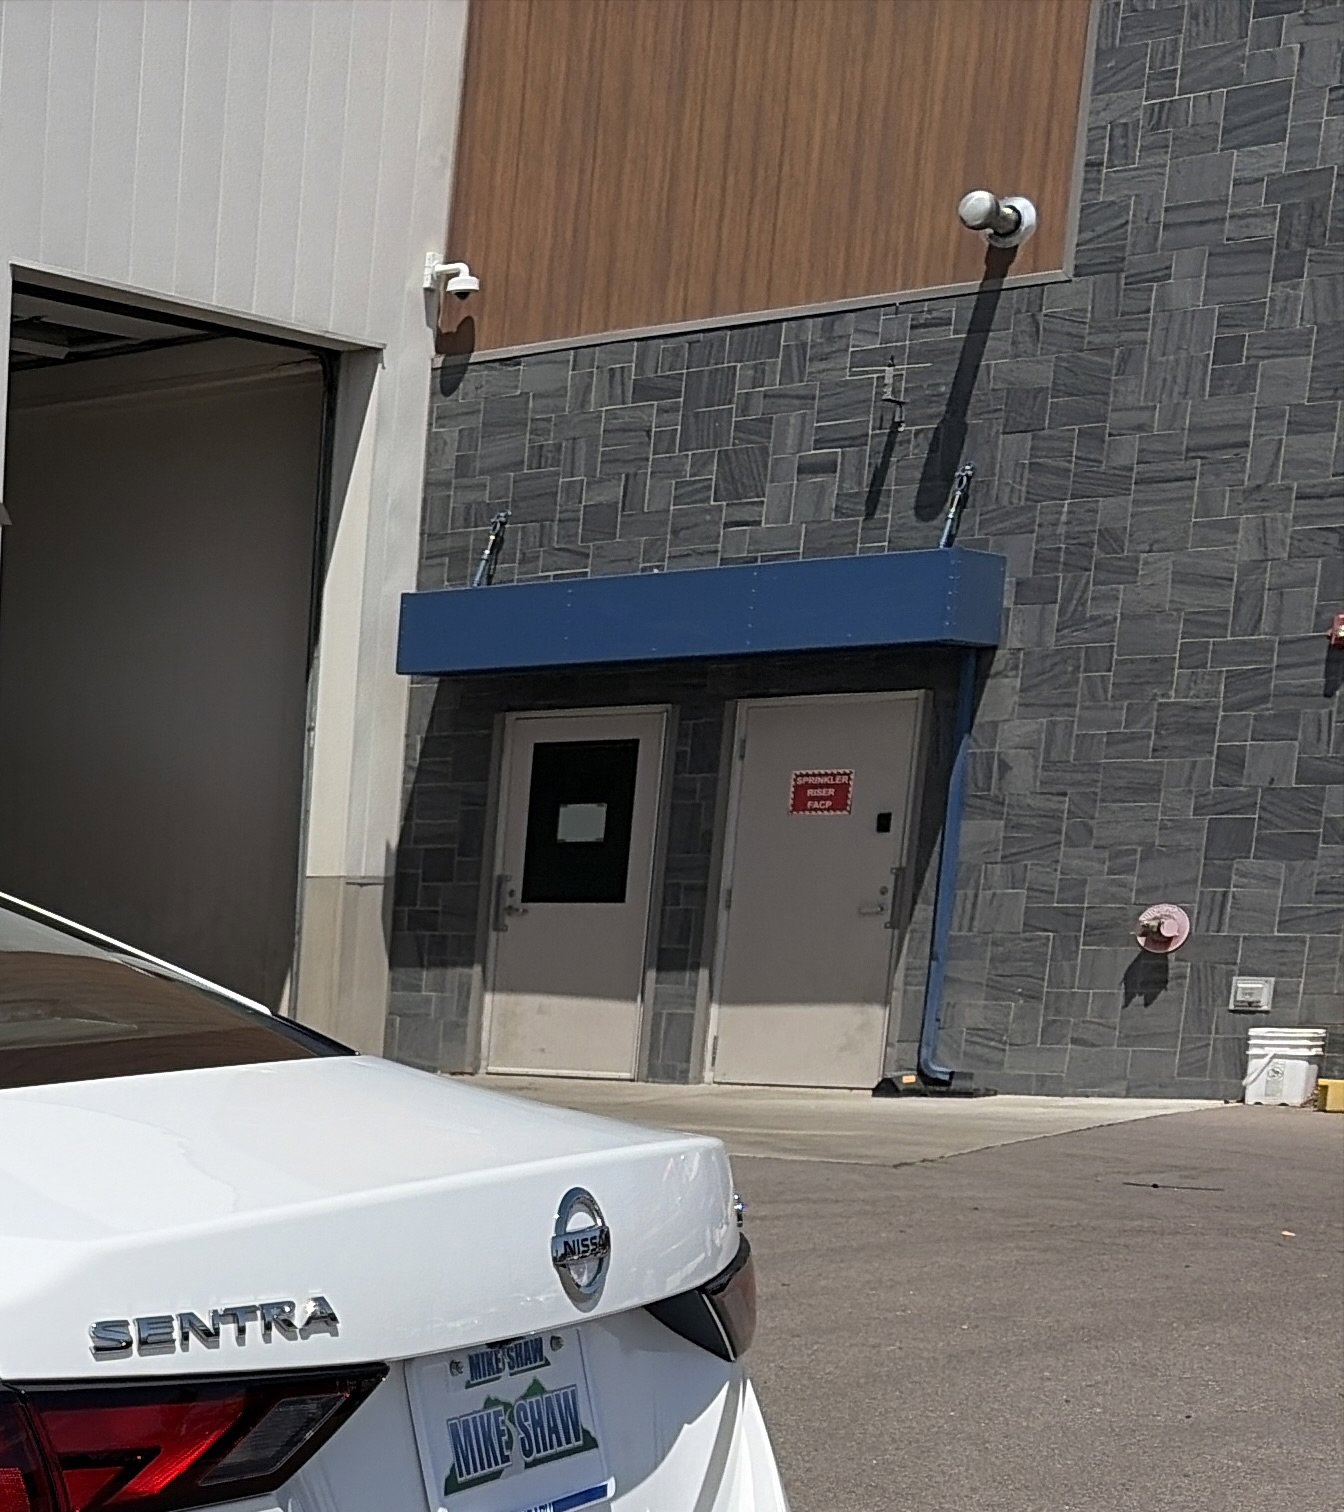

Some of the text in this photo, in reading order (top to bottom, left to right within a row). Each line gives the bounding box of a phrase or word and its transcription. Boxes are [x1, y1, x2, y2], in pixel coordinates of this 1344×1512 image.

[797, 775, 849, 785] SPRINKLER
[807, 788, 835, 797] RISER
[807, 800, 832, 809] FACP
[89, 1295, 339, 1356] SENTRA
[467, 1337, 544, 1383] MIKE SHAW
[447, 1387, 582, 1479] MIKE SHAW
